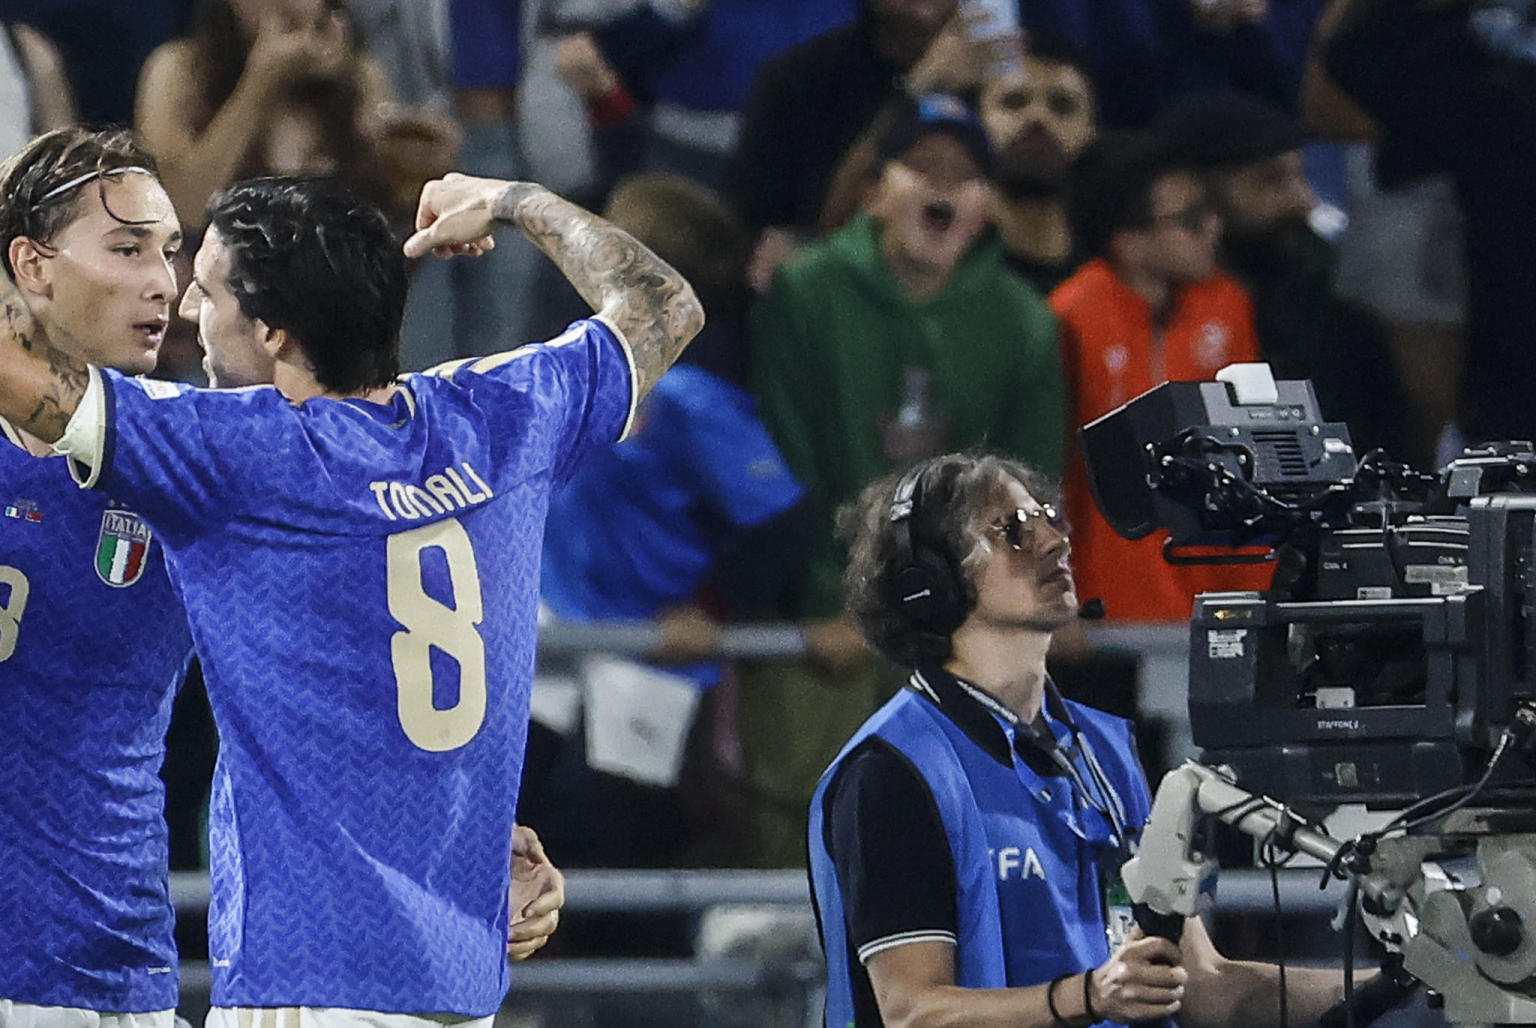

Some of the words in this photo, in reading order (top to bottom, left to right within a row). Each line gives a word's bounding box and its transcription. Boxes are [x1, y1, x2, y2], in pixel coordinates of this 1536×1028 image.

[369, 462, 494, 520] TONALI
[104, 513, 146, 537] ITALIA
[386, 517, 487, 752] 8
